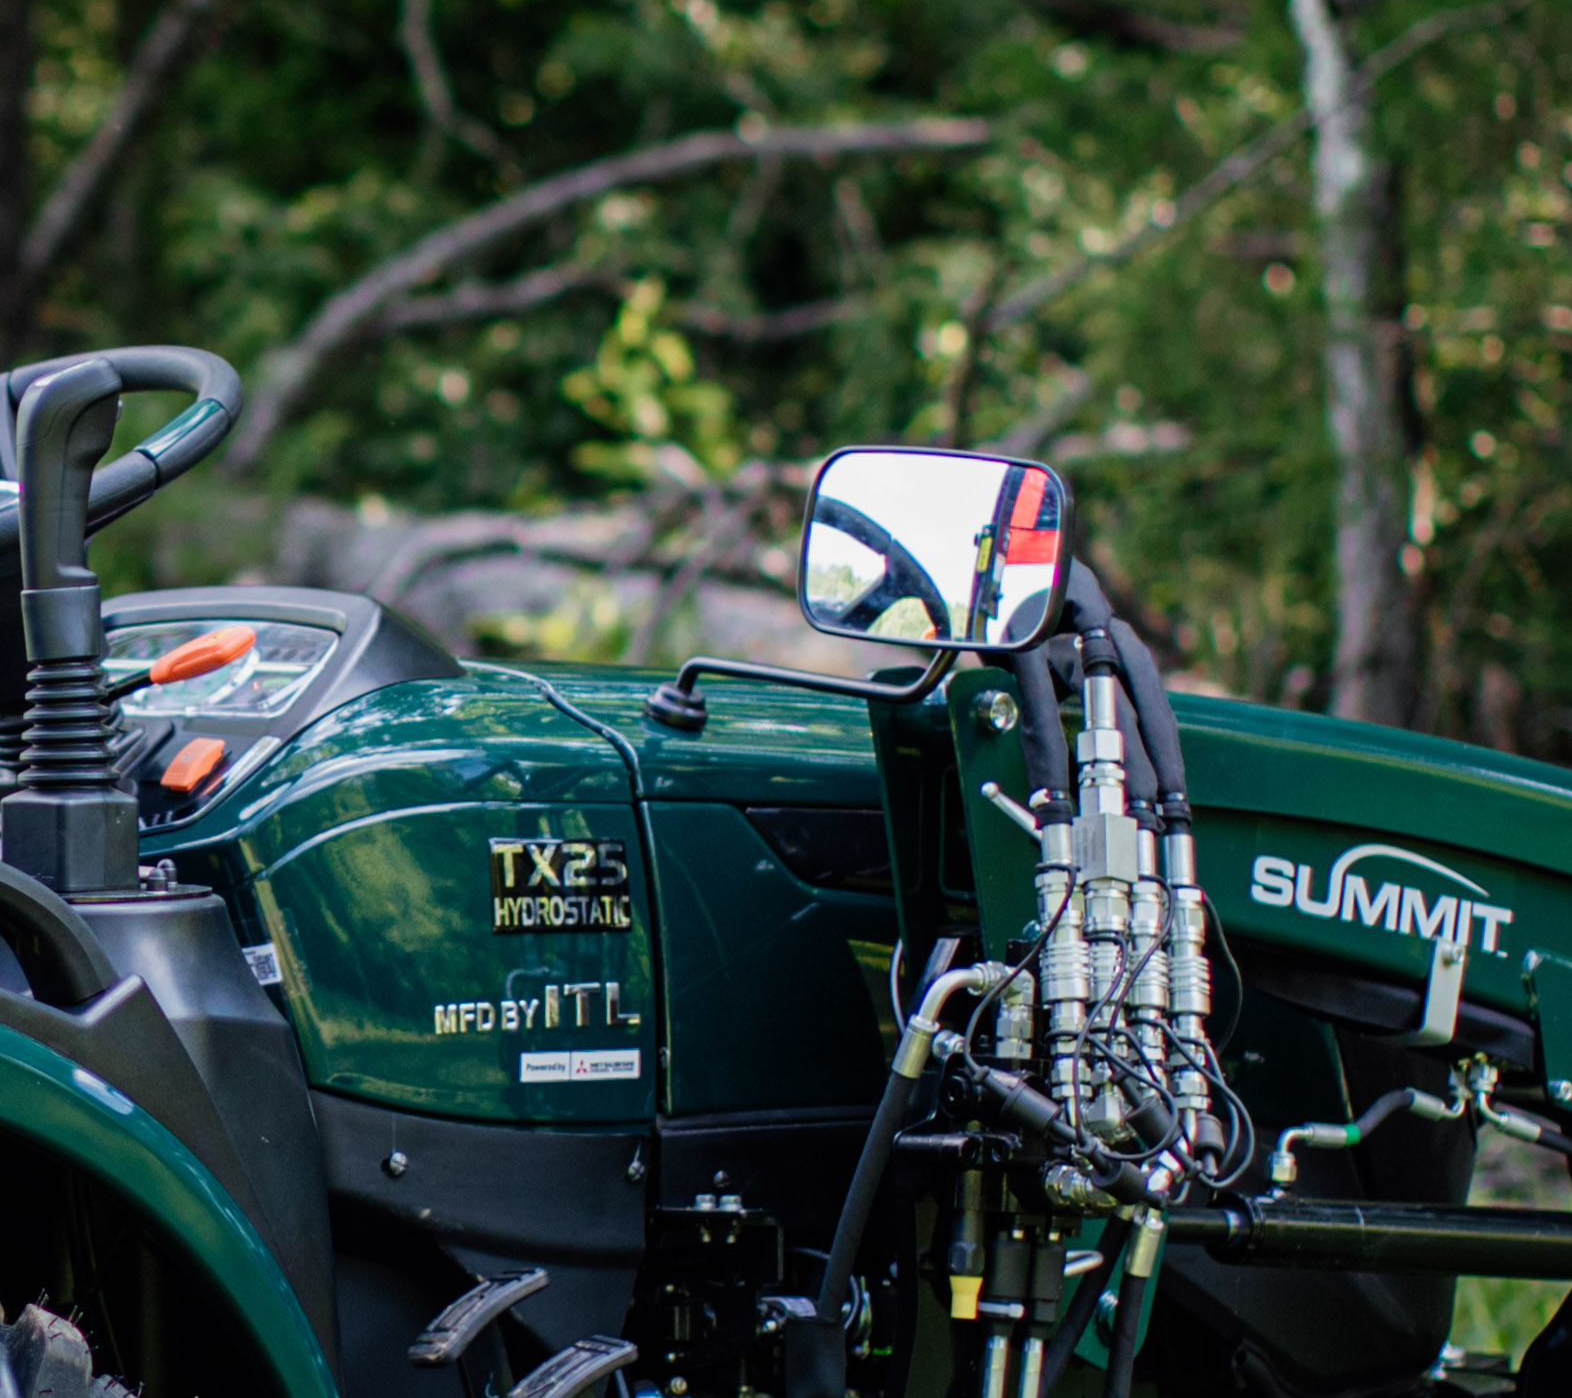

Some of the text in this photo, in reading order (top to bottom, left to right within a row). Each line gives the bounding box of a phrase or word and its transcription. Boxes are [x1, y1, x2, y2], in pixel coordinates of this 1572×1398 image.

[494, 843, 628, 888] TX25
[494, 895, 632, 928] HYDROSTATIC
[1250, 844, 1514, 954] SUMMIT
[434, 981, 641, 1036] MFD BY ITL
